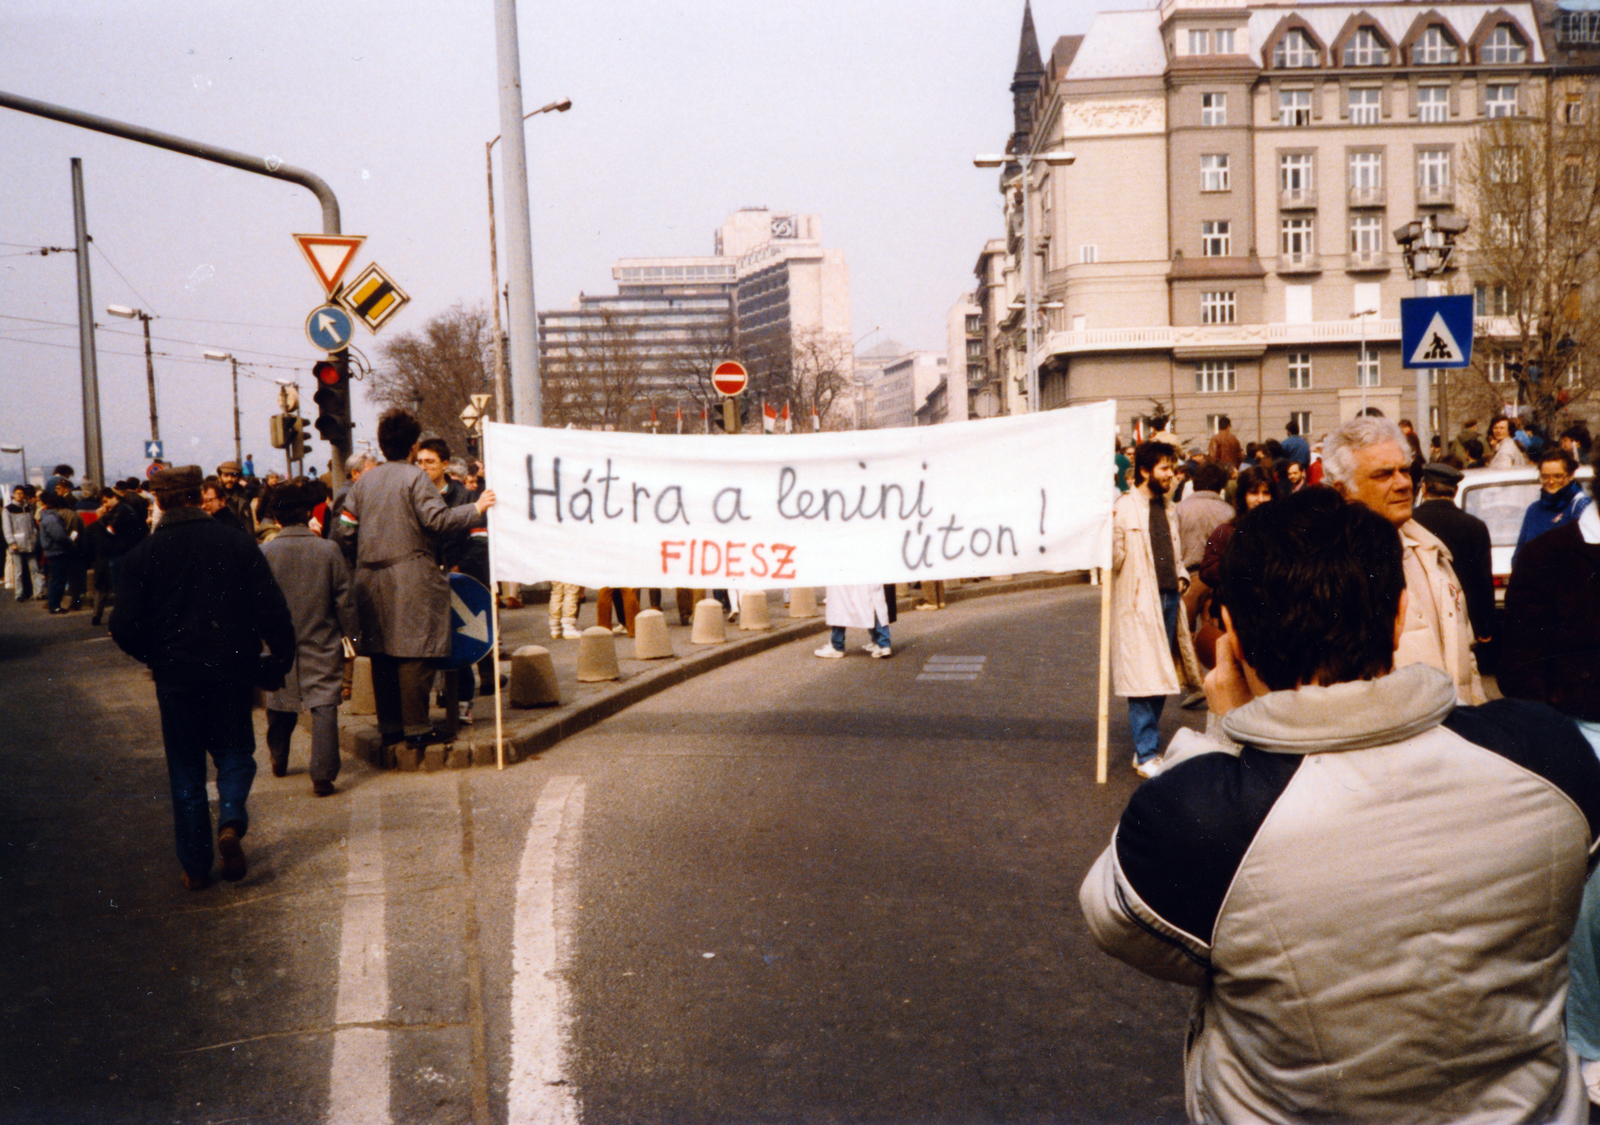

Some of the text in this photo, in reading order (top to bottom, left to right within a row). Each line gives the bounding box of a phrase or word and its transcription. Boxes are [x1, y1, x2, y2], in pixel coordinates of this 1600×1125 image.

[526, 454, 933, 525] Hátra a lenini
[660, 539, 797, 579] FIDESZ
